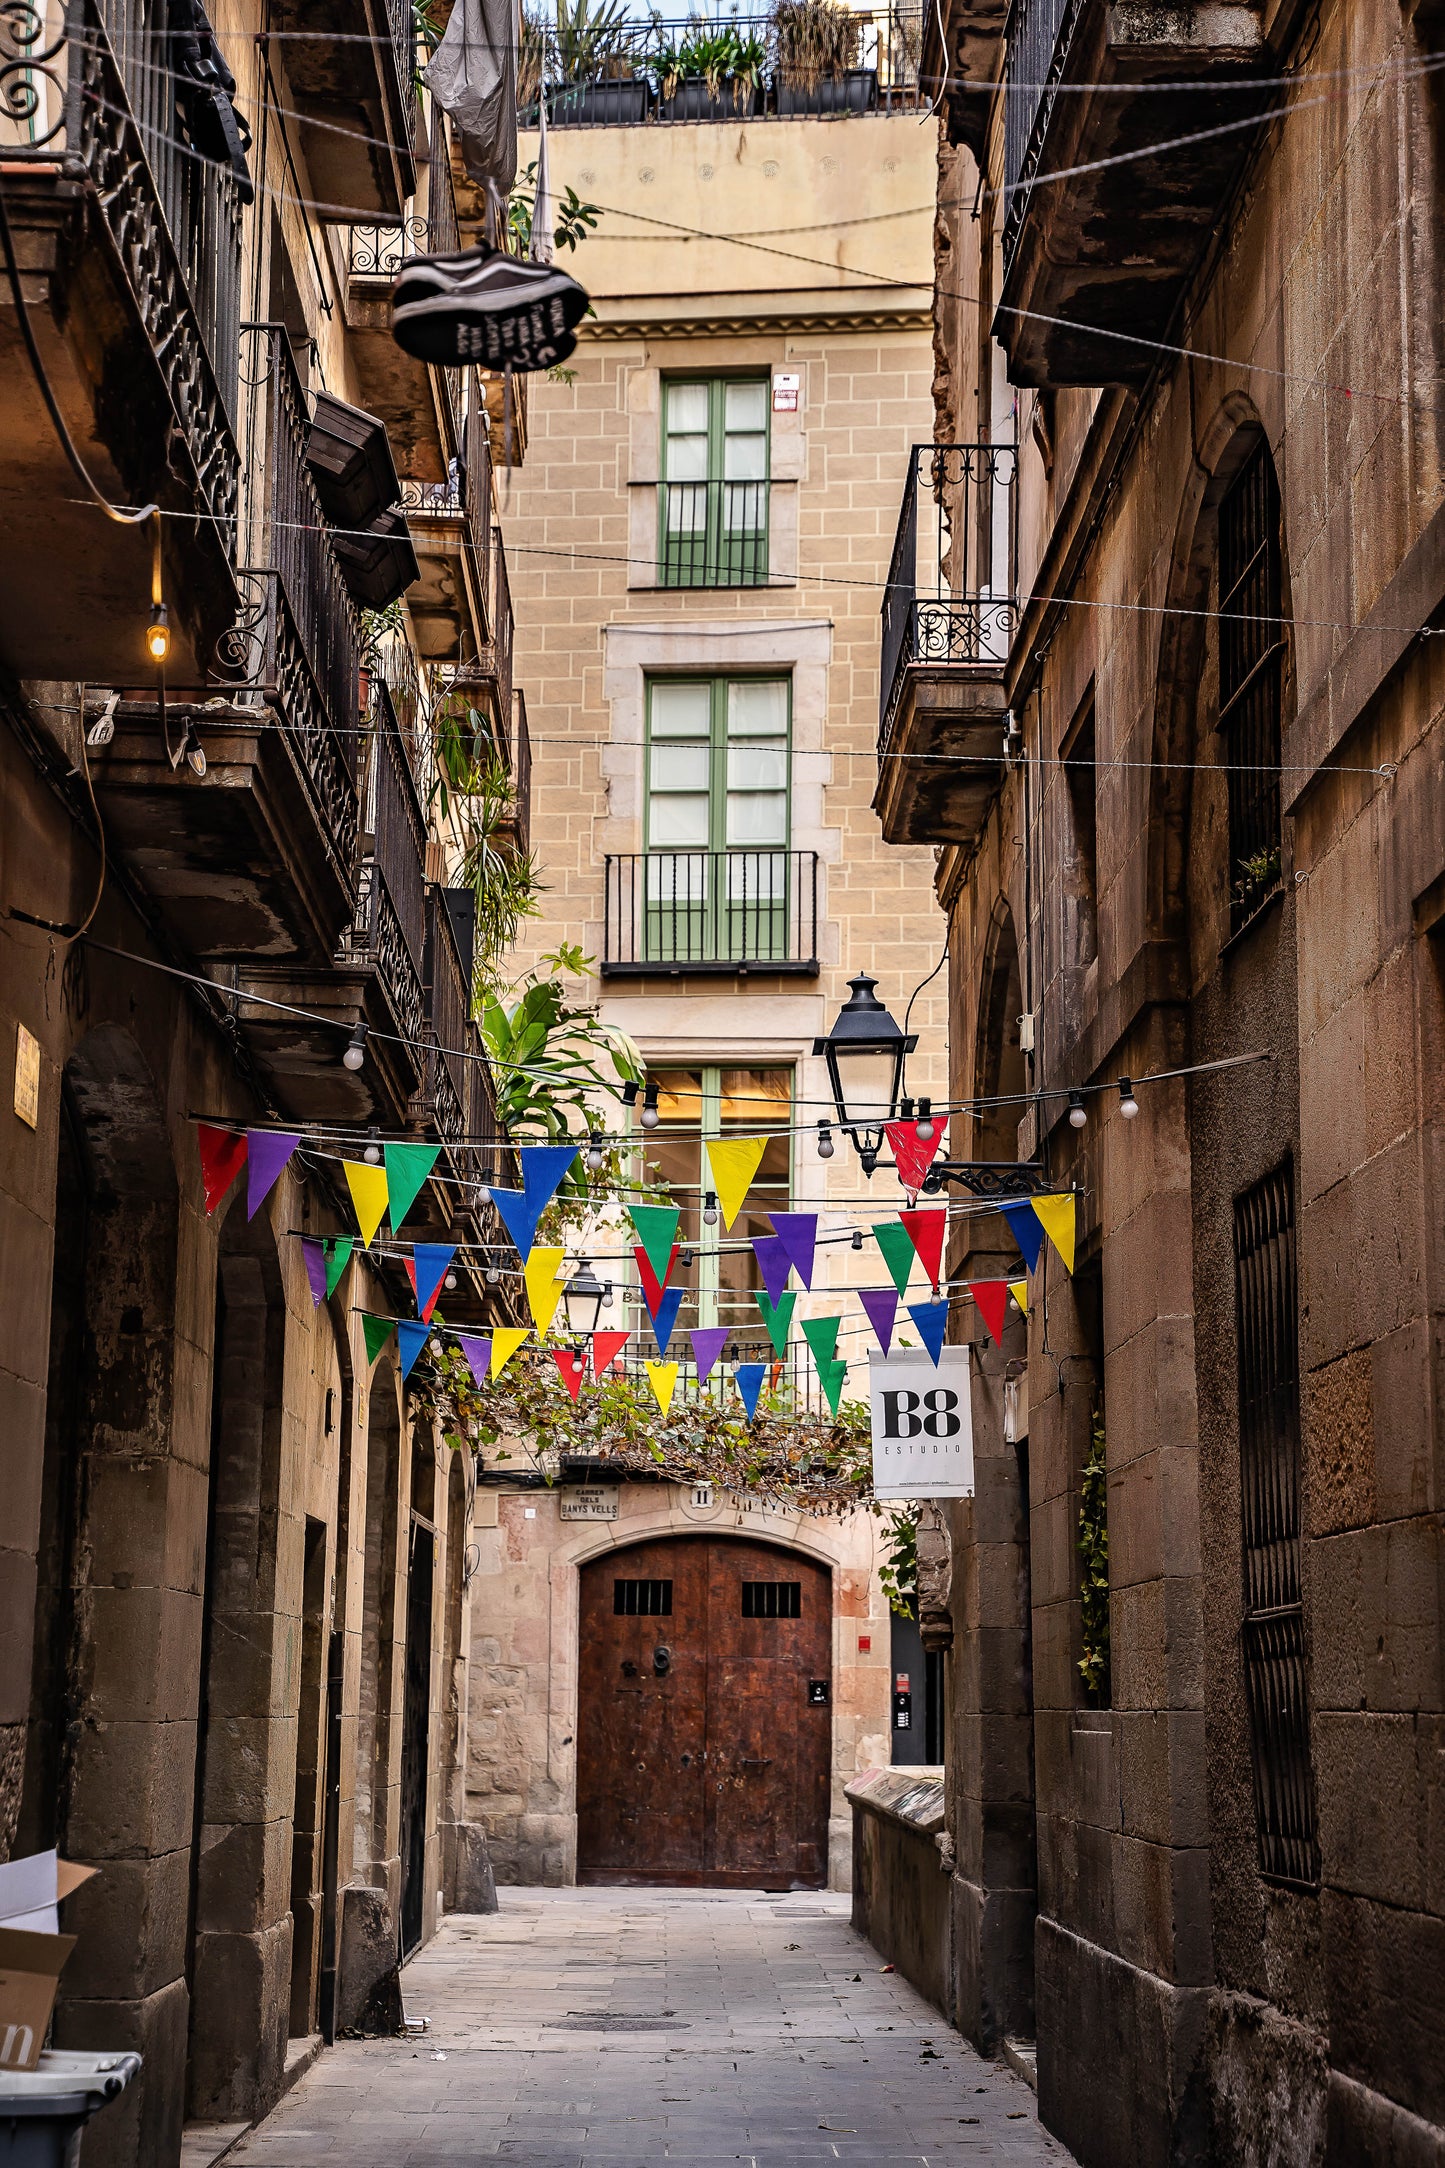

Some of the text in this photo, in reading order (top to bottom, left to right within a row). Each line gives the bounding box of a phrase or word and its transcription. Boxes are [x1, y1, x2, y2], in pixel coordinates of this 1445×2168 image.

[878, 1388, 961, 1439] B8
[885, 1444, 960, 1455] ESTUDIO
[562, 1504, 617, 1513] BANYS VELLS
